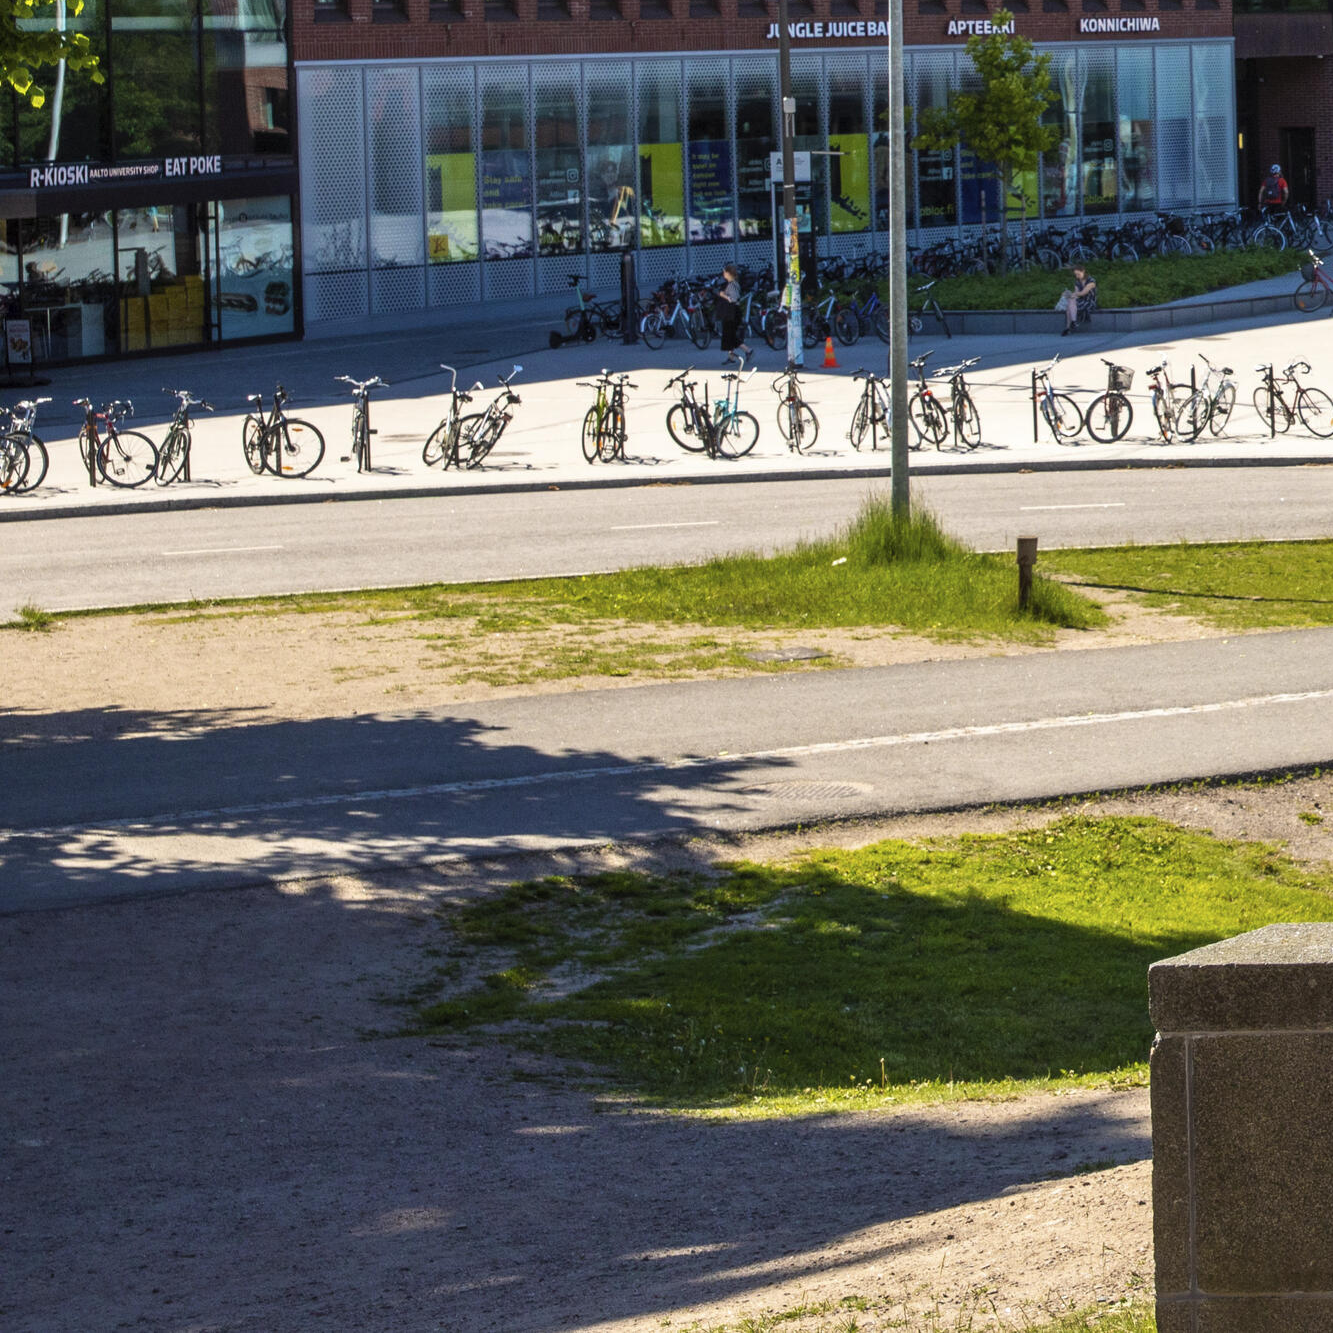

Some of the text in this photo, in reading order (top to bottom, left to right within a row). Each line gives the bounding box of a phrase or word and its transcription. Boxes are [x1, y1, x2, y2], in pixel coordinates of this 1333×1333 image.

[825, 21, 865, 37] JUICE
[867, 21, 890, 36] BA
[1080, 17, 1160, 33] KONNICHIWA
[165, 155, 221, 177] EAT POKE
[30, 165, 159, 188] R-KIOSKI AALTO UNIVERSITY SHOP
